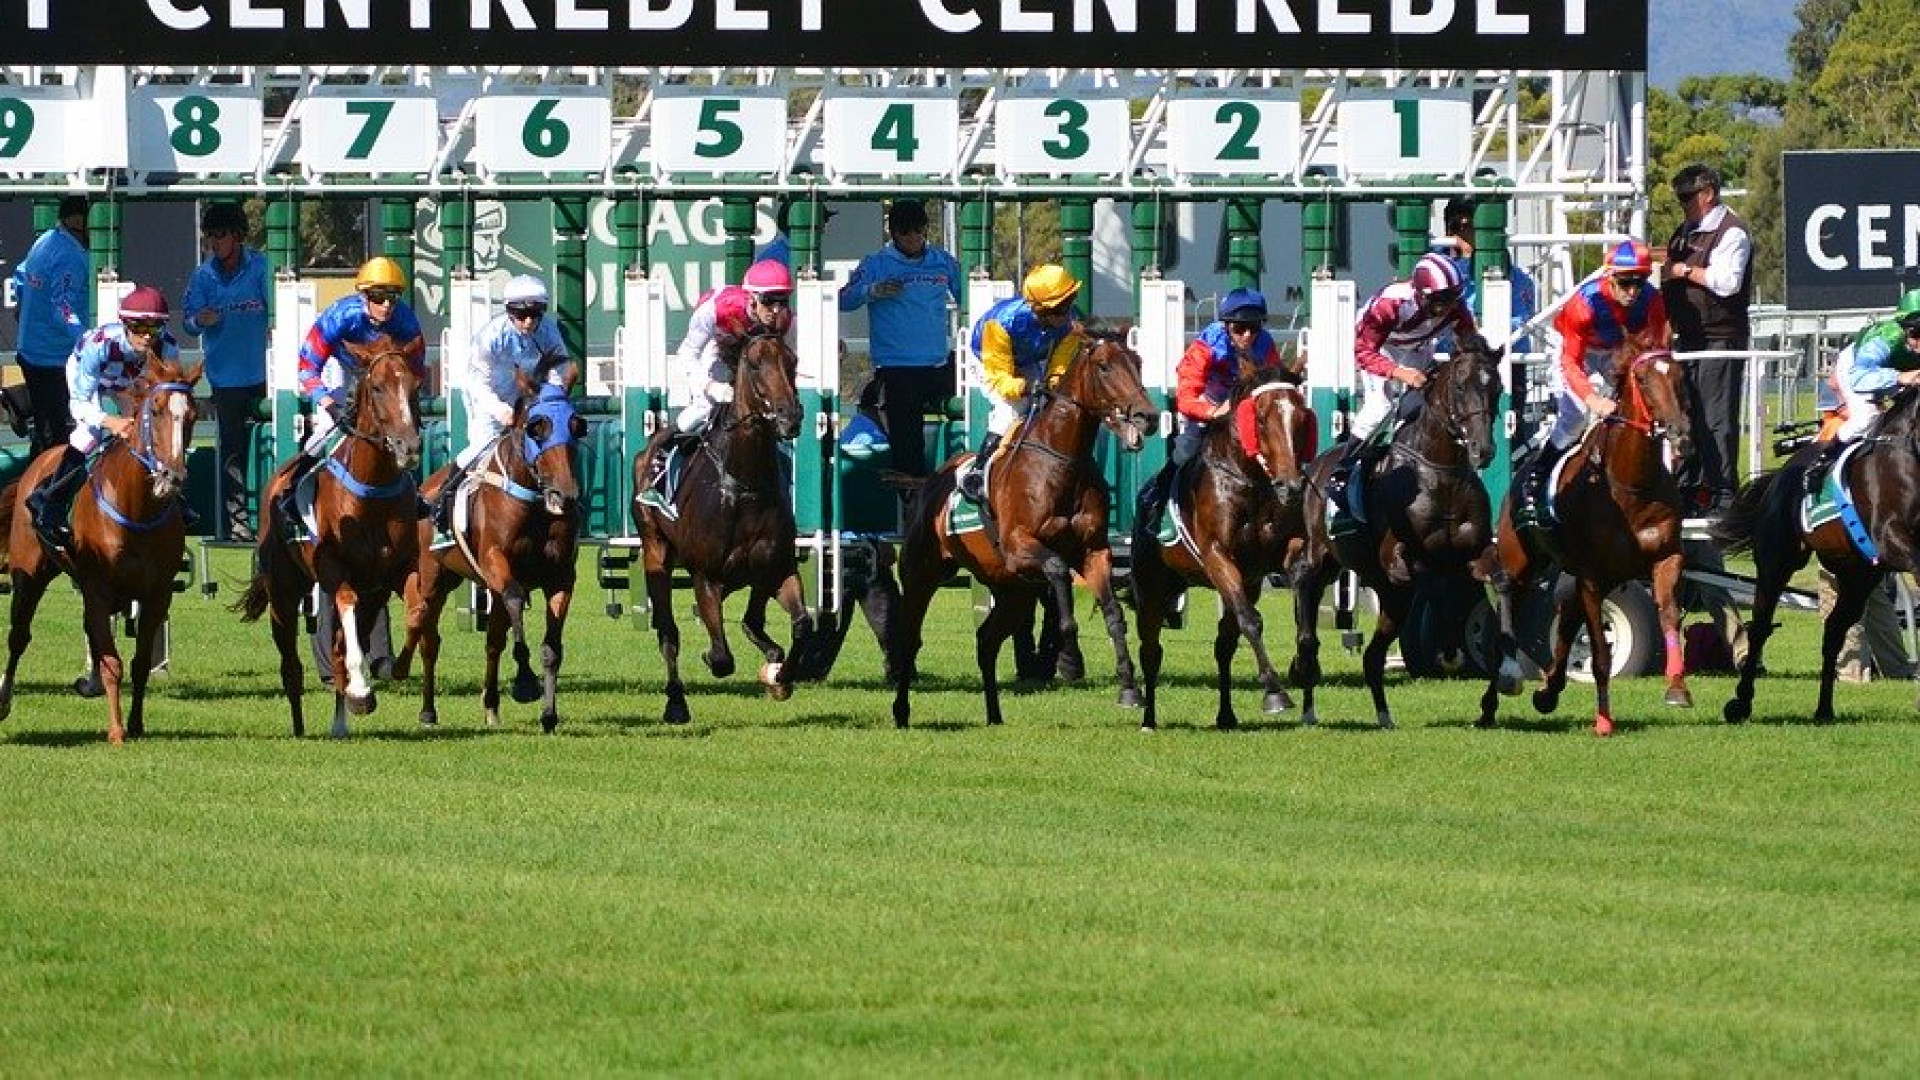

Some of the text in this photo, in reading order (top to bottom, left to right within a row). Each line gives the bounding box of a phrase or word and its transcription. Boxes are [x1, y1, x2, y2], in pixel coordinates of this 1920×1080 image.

[0, 97, 34, 157] 9
[170, 95, 221, 156] 8
[345, 102, 394, 159] 7
[521, 98, 570, 158] 6
[694, 99, 744, 158] 5
[871, 103, 919, 162] 4
[1042, 98, 1090, 160] 3
[1214, 102, 1262, 161] 2
[1392, 100, 1420, 157] 1
